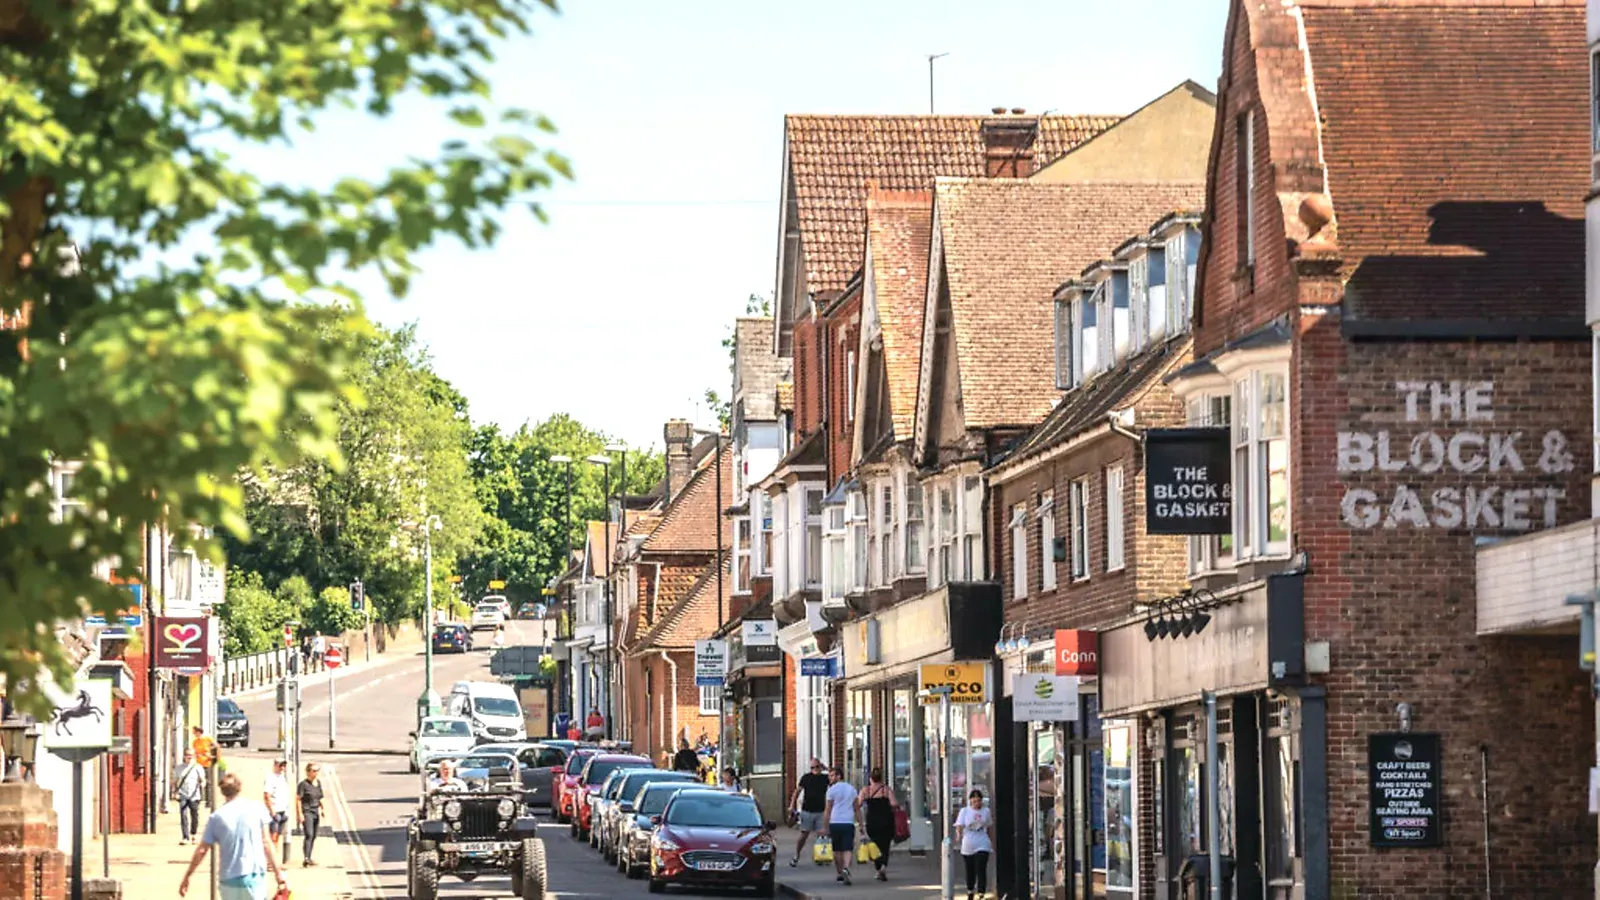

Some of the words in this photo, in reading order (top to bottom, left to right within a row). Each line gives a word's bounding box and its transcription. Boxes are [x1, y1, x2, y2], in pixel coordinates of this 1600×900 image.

[1396, 380, 1494, 421] THE
[1337, 430, 1524, 474] BLOCK
[1537, 429, 1575, 474] &
[1173, 466, 1207, 481] THE
[1153, 483, 1218, 499] BLOCK
[1222, 483, 1231, 498] &
[1155, 502, 1230, 517] GASKET
[1341, 485, 1566, 529] GASKET
[1061, 649, 1096, 663] Conn
[1376, 762, 1404, 770] CRAFT
[1406, 762, 1431, 770] BEERS
[1380, 771, 1427, 779] COCKTAILS
[1384, 788, 1424, 798] PIZZAS
[1376, 807, 1409, 815] SEATING
[1411, 807, 1433, 815] AREA
[1396, 818, 1426, 826] SPORTS
[1401, 829, 1420, 839] Sport
